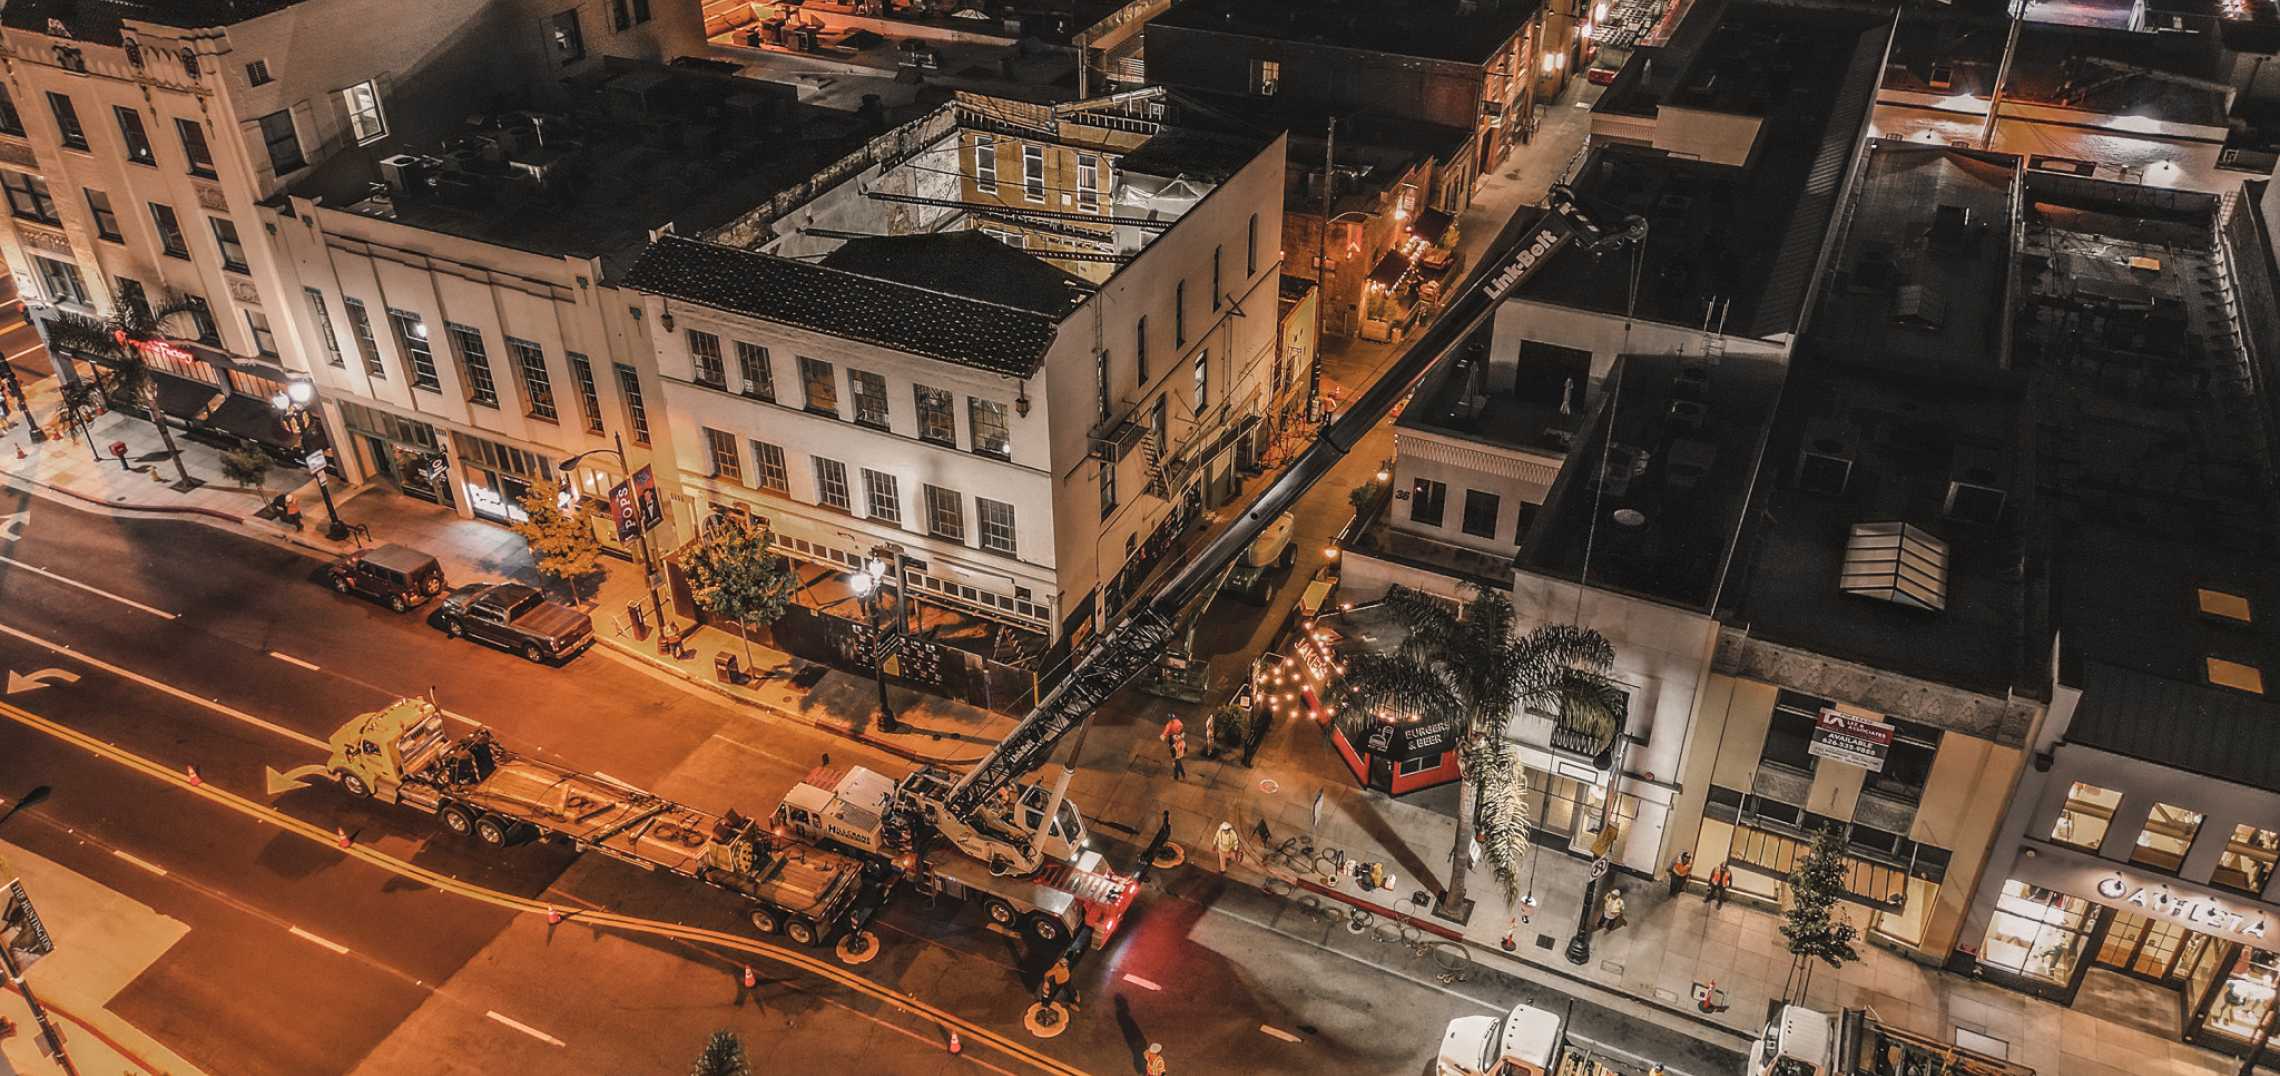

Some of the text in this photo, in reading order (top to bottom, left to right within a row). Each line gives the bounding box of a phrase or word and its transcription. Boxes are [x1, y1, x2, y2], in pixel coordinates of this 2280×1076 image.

[1483, 230, 1558, 300] Link-Belt
[1405, 722, 1450, 739] BURGERS
[1416, 734, 1443, 749] BEER
[1827, 732, 1874, 749] AVAILABLE
